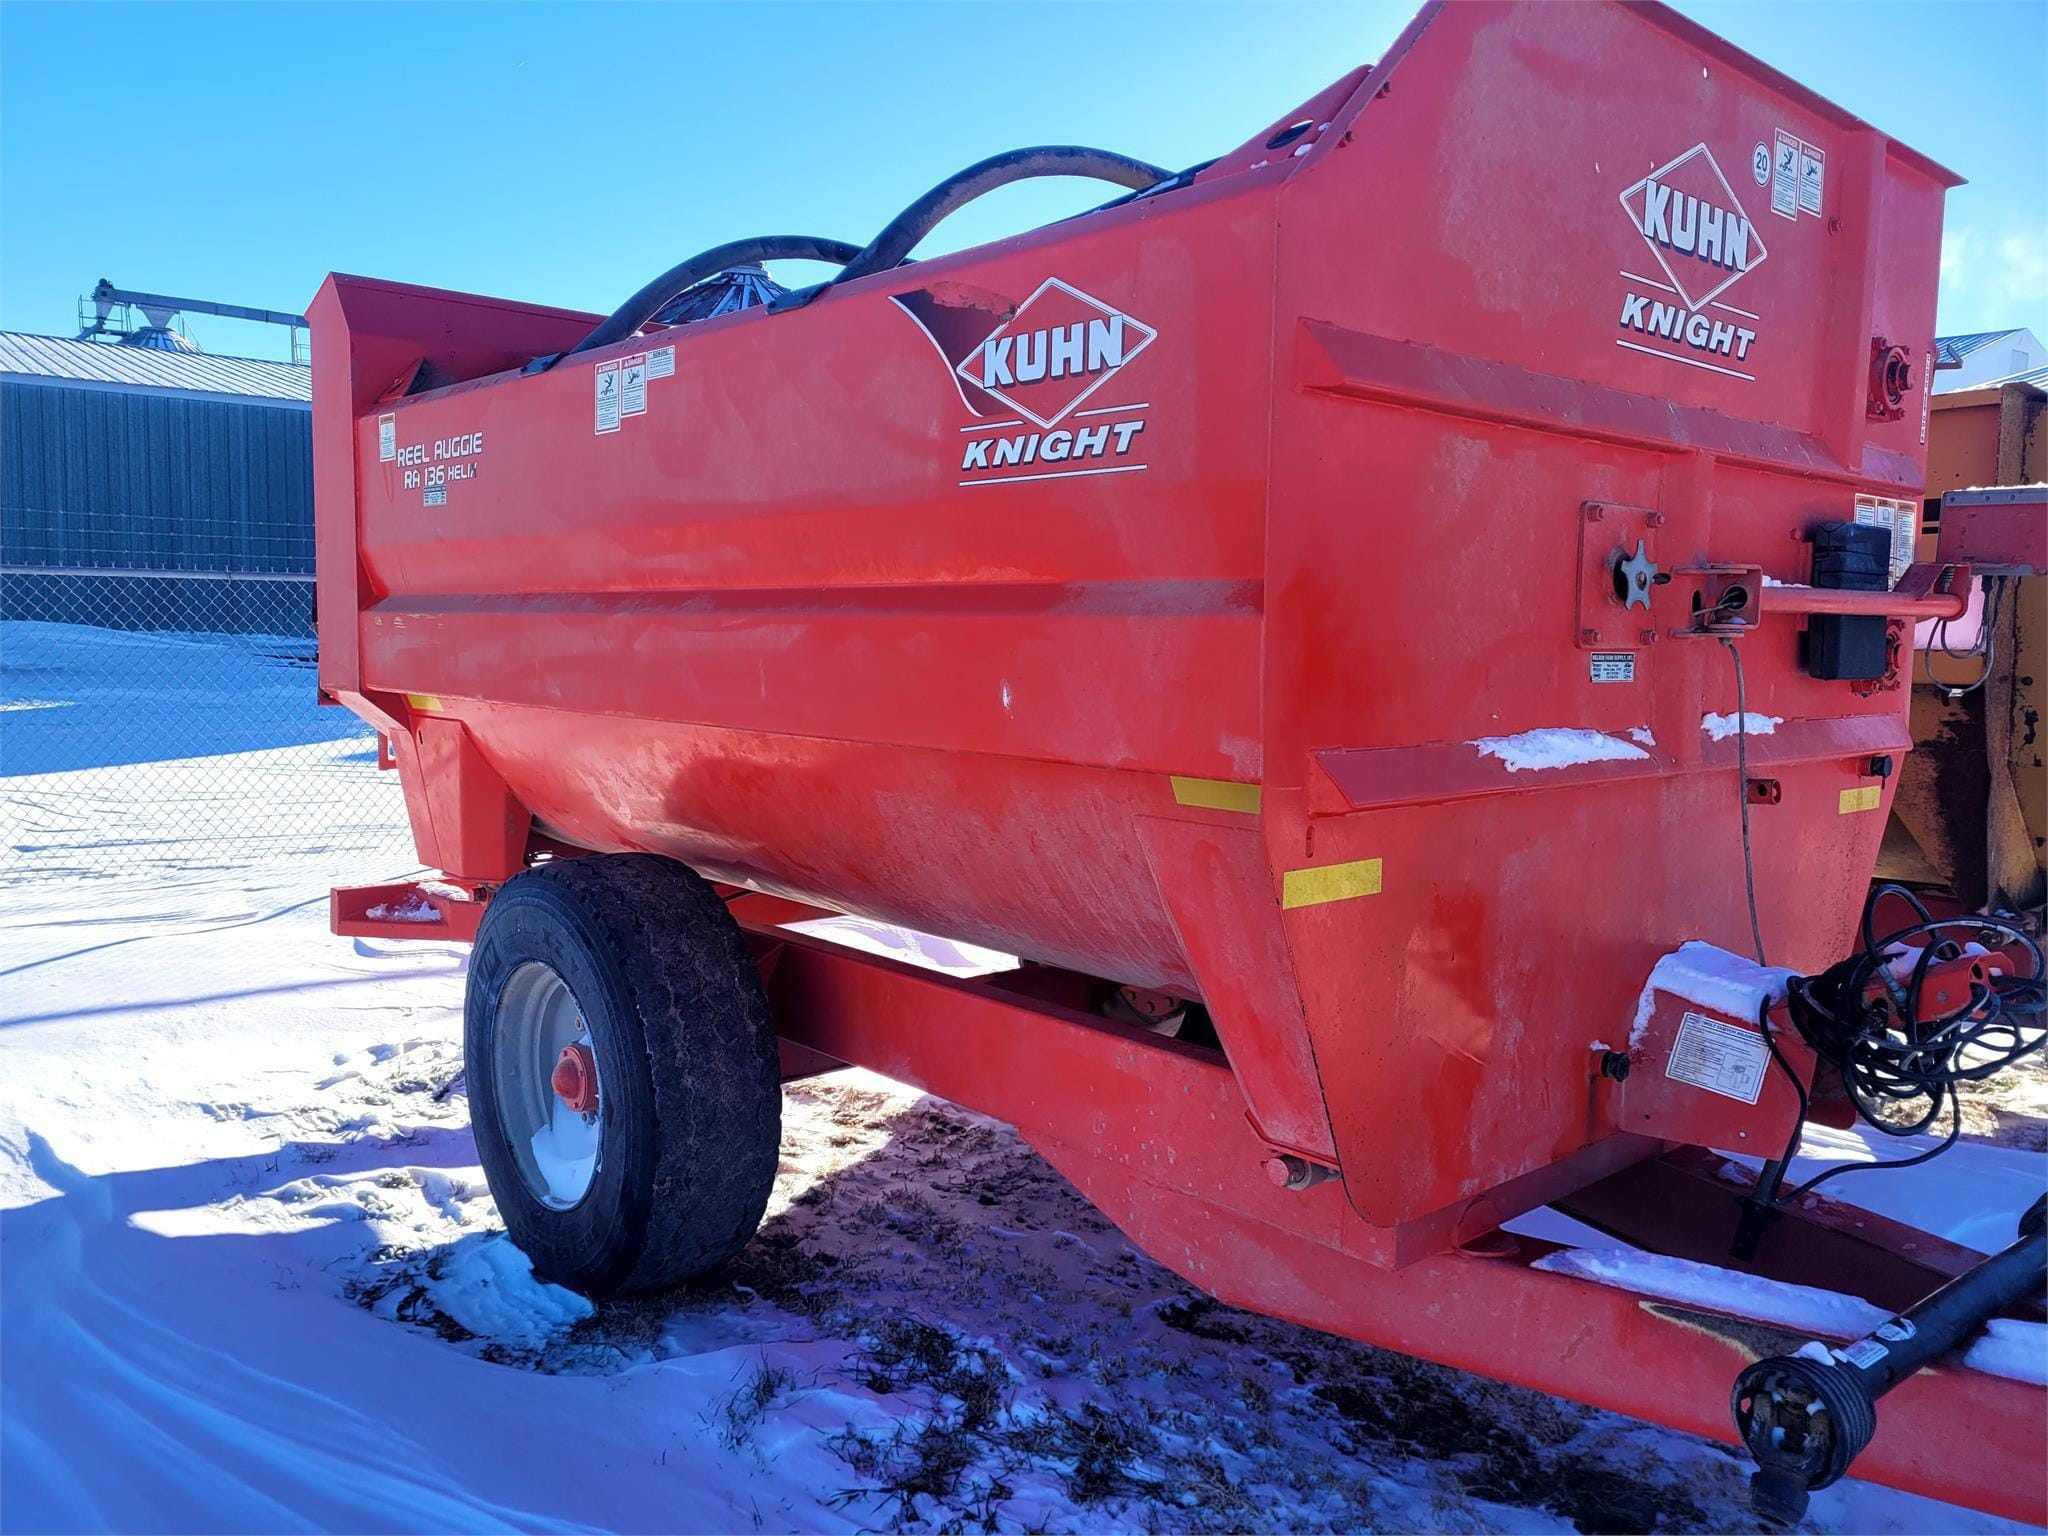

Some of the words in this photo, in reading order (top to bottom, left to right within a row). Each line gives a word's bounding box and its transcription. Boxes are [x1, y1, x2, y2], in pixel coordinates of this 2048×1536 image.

[1756, 151, 1768, 172] 20
[1643, 178, 1749, 273] KUHN
[1619, 292, 1756, 361] KNIGHT
[983, 315, 1123, 390] KUHN
[397, 443, 430, 468] REEL
[434, 431, 483, 461] AUGGIE
[961, 420, 1145, 470] KNIGHT
[404, 469, 421, 490] RA
[424, 464, 446, 487] 136
